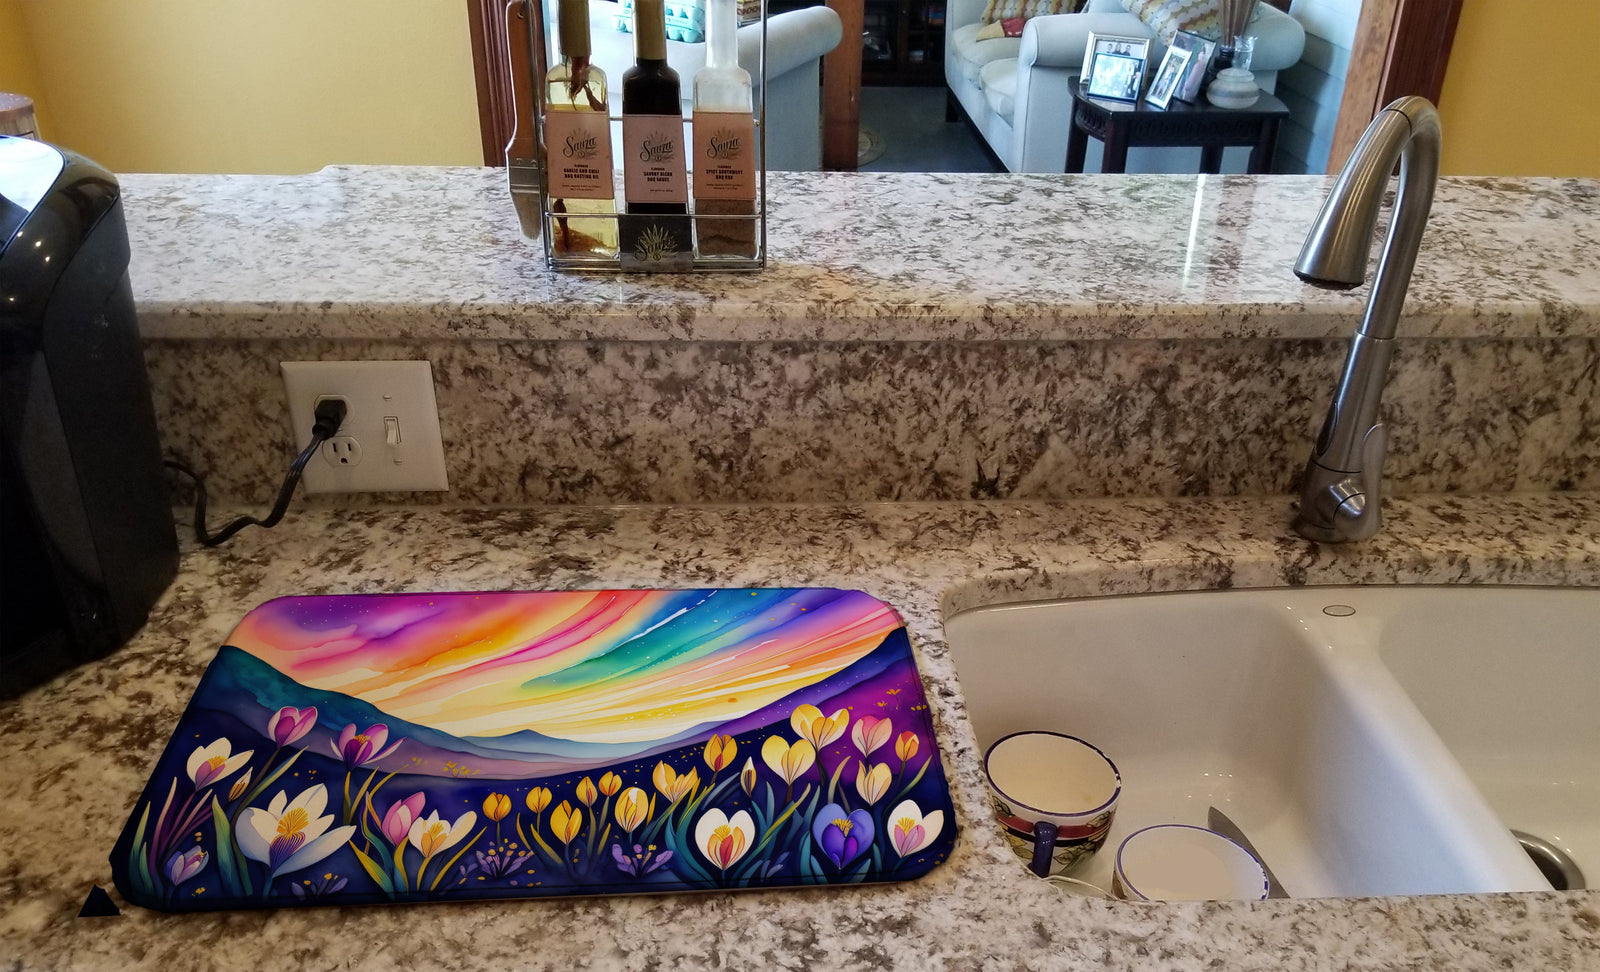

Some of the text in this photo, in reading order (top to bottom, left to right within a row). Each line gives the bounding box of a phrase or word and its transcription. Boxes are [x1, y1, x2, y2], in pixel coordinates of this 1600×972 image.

[563, 136, 597, 158] Sauza
[640, 140, 674, 161] Sauza
[707, 137, 740, 158] Sauza
